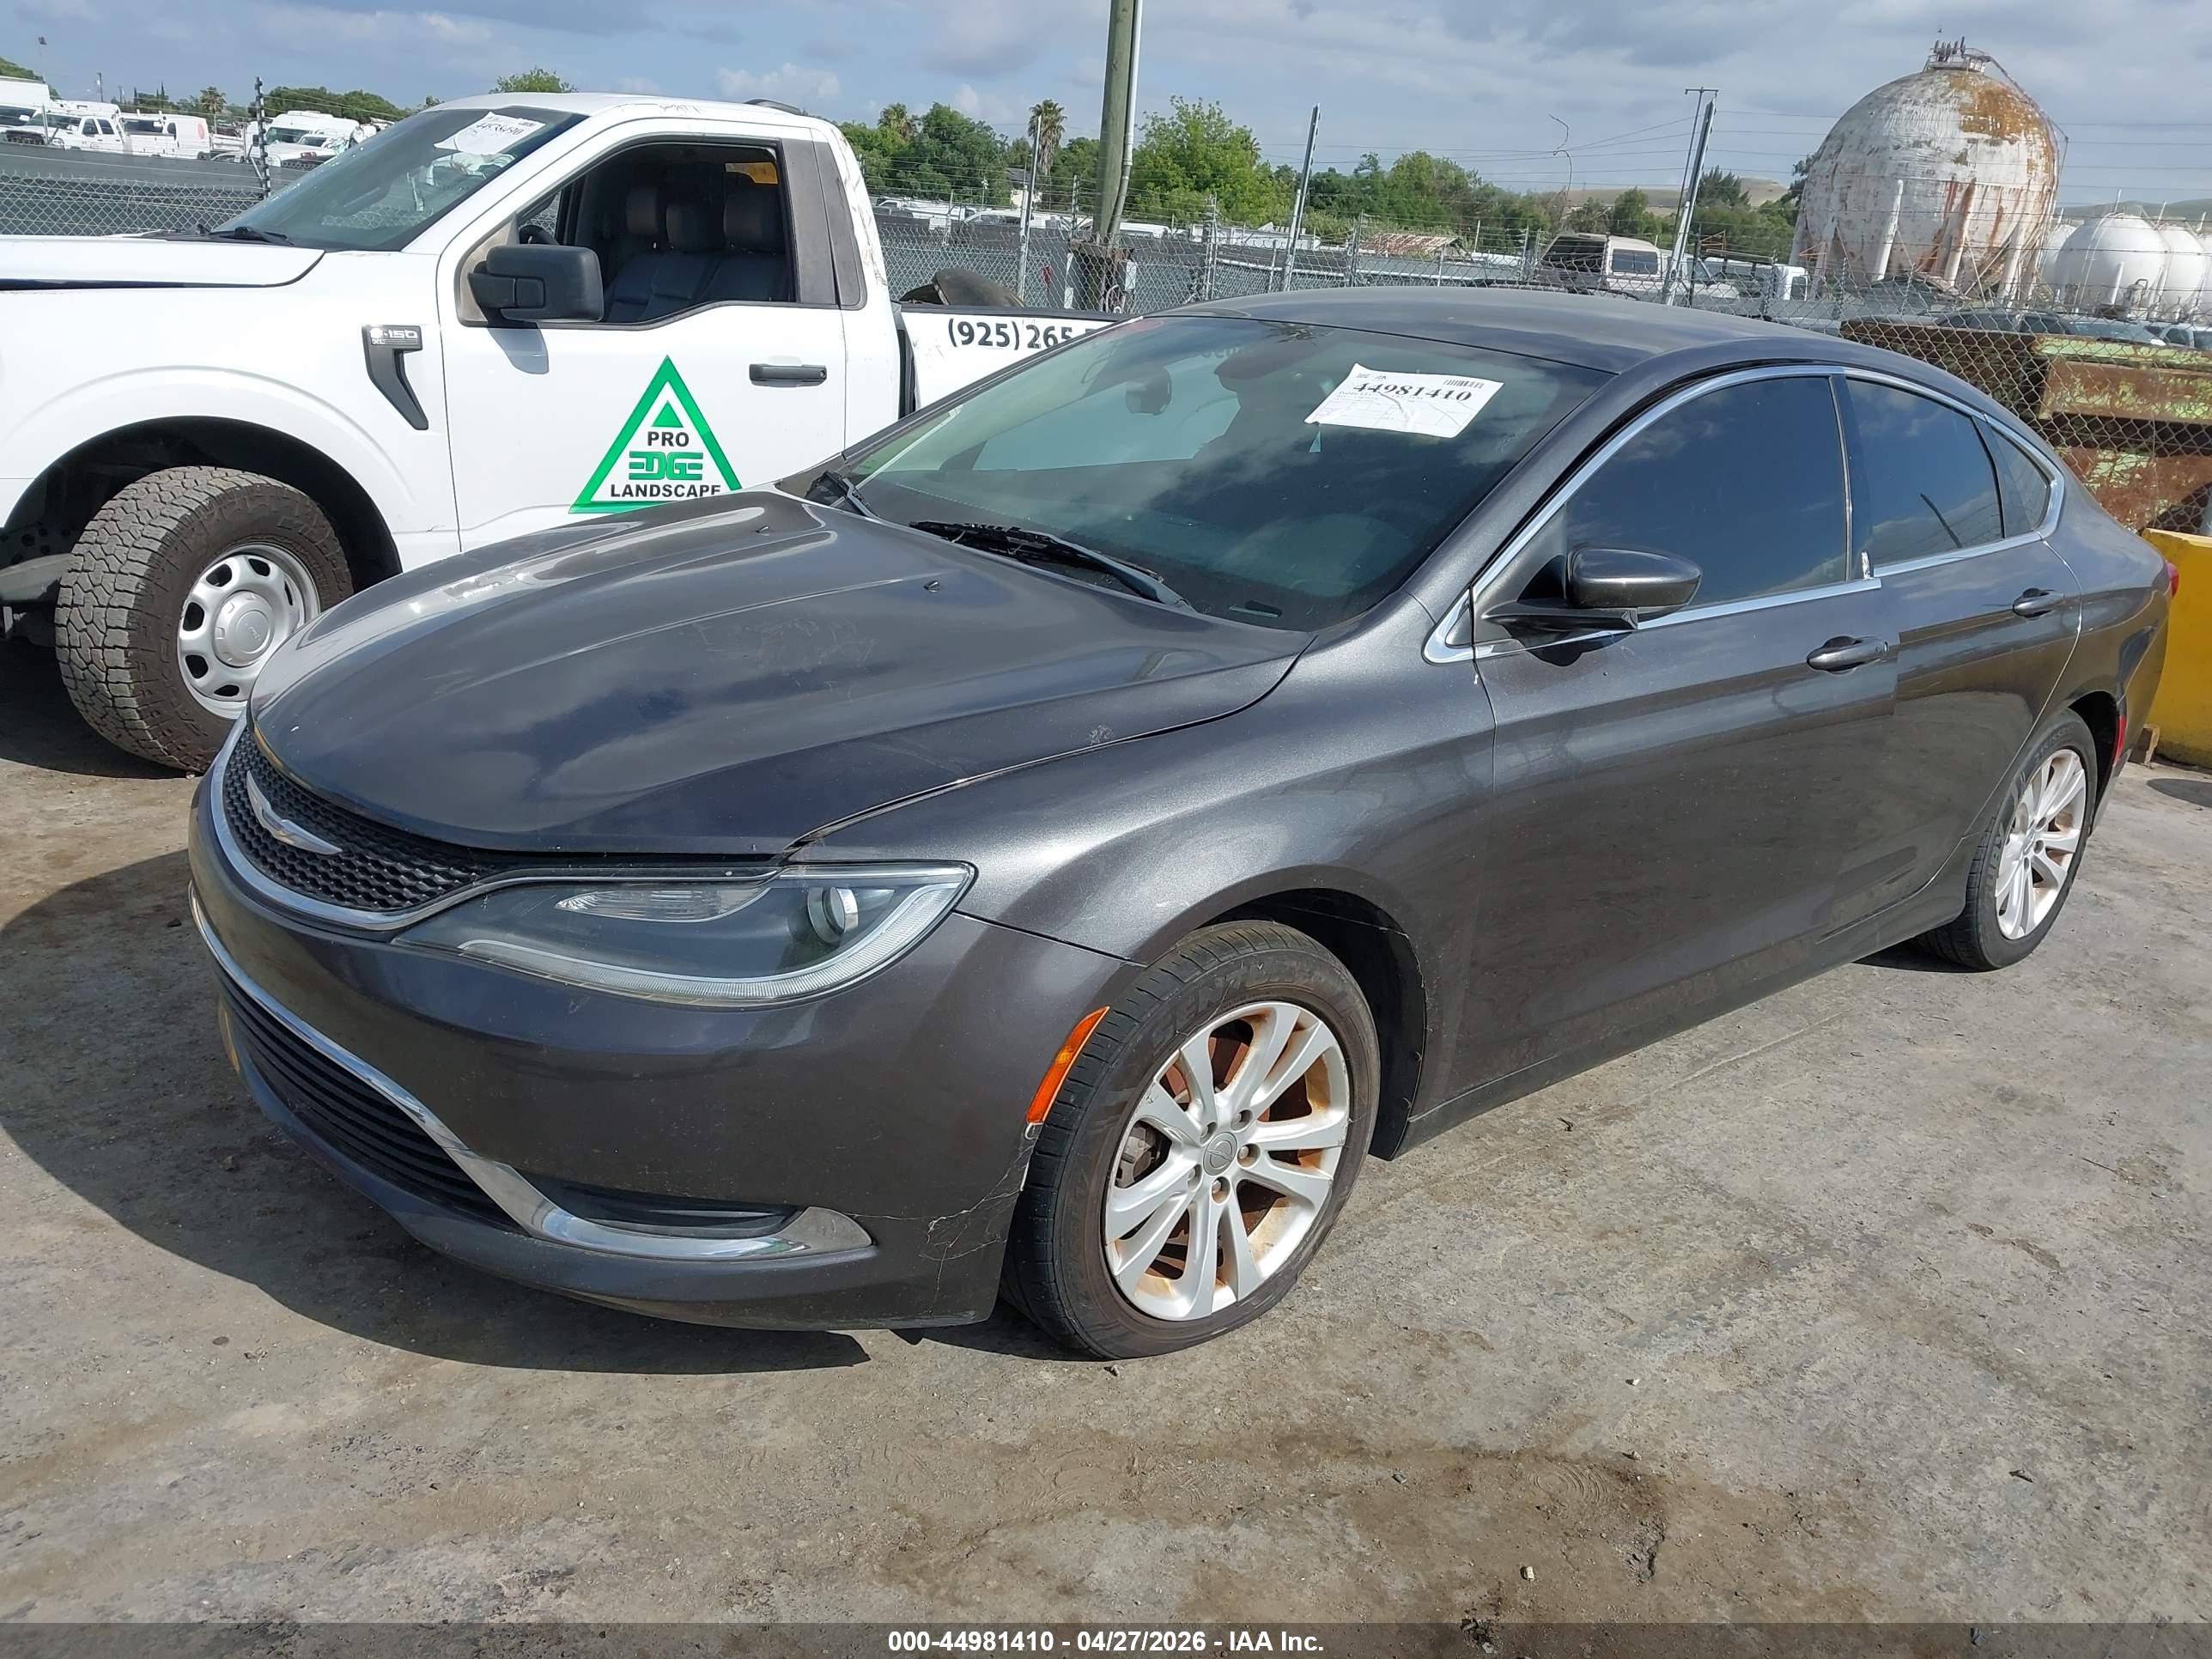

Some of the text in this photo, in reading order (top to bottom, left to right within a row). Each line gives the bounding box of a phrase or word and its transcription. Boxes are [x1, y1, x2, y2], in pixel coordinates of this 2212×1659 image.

[370, 328, 418, 339] -150
[948, 318, 1097, 350] (925) 265
[1353, 382, 1473, 402] 44981410
[647, 431, 690, 447] PRO
[629, 451, 704, 481] EDGE
[611, 483, 721, 498] LANDSCAPE
